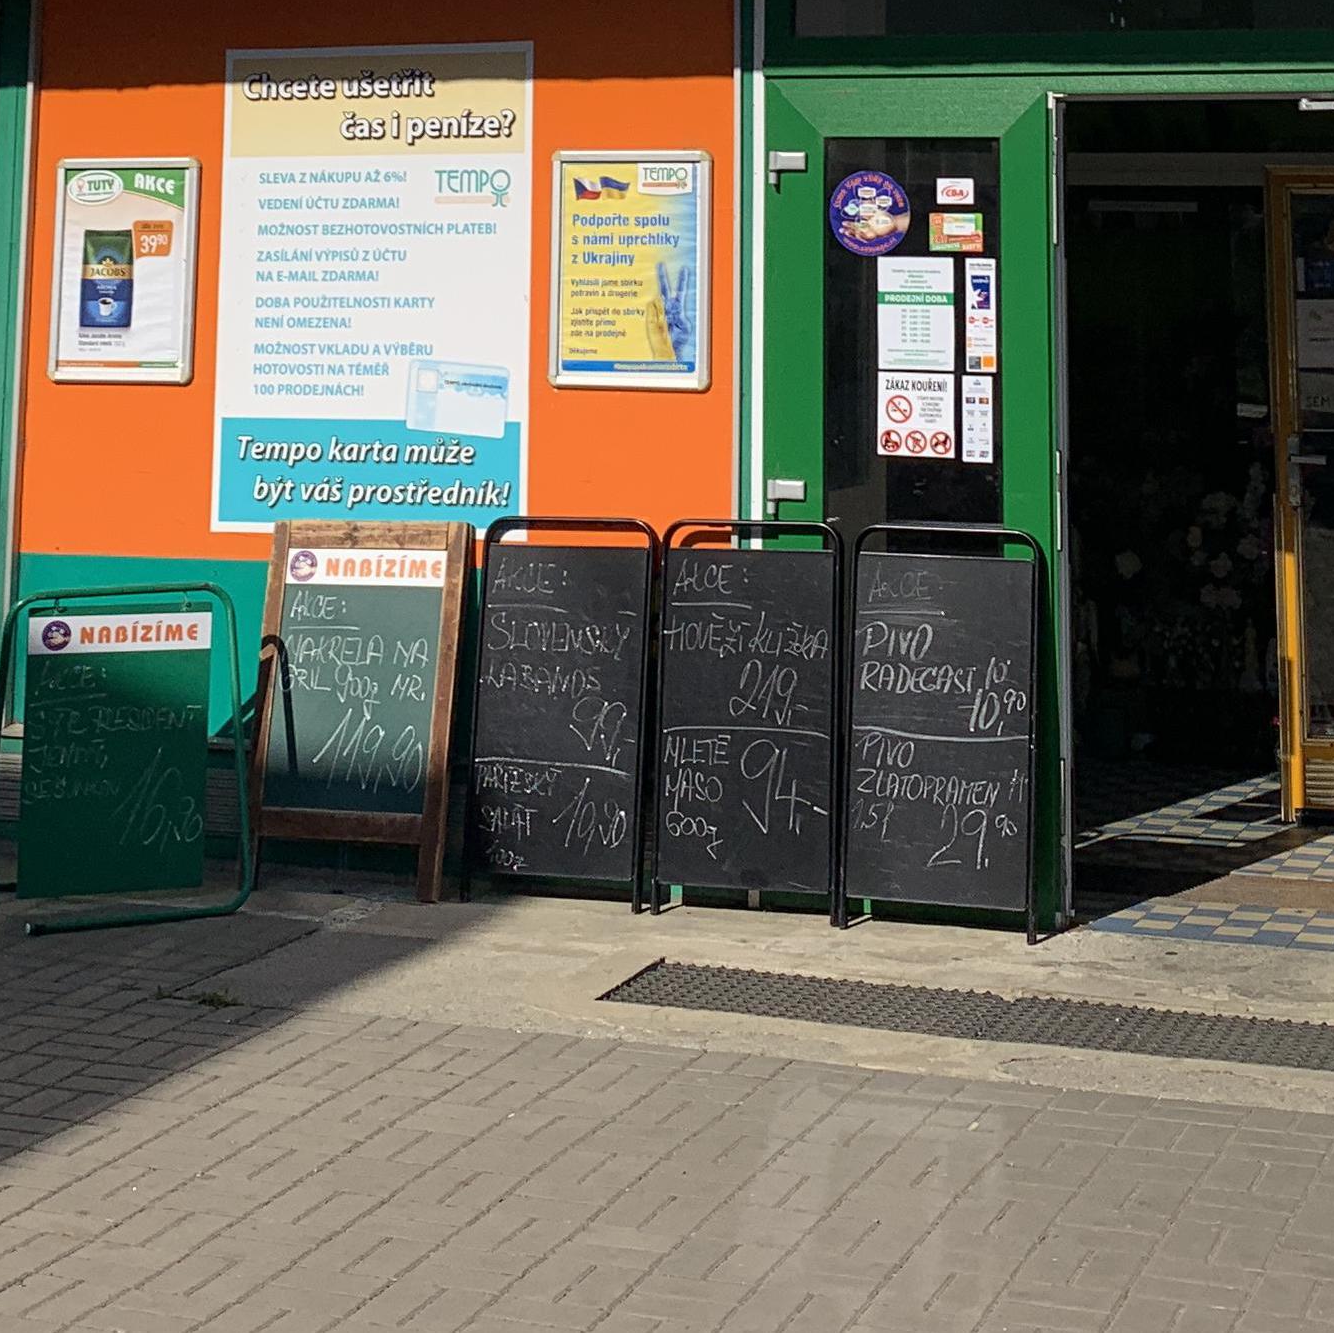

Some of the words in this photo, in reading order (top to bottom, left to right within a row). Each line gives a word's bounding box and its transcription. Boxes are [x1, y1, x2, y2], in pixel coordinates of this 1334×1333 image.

[242, 72, 337, 100] Chcete
[342, 69, 436, 98] ušetřit
[340, 111, 385, 140] čas
[391, 111, 400, 140] i
[406, 109, 516, 146] peníze?
[259, 171, 296, 185] SLEVA
[299, 171, 308, 184] Z
[309, 169, 362, 184] NÁKUPU
[365, 168, 381, 183] AŽ
[383, 170, 407, 183] 6%!
[434, 168, 511, 195] TEMPO
[643, 167, 688, 182] TEMPO
[87, 178, 115, 191] TUTY
[133, 172, 175, 195] AKCE
[258, 196, 303, 210] VEDENÍ
[305, 195, 339, 210] ÚČTU
[342, 196, 400, 210] ZDARMA!
[257, 223, 319, 236] MOŽNOST
[321, 221, 444, 235] BEZHOTOVOSTNÍCH
[446, 222, 497, 235] PLATEB!
[572, 213, 629, 229] Podpořte
[634, 214, 670, 229] spolu
[571, 235, 579, 245] s
[583, 232, 614, 246] námi
[618, 233, 680, 249] uprchlíky
[256, 249, 313, 262] ZASÍLÁNÍ
[315, 248, 359, 262] VÝPISŮ
[362, 250, 370, 262] Z
[372, 248, 407, 262] ÚČTU
[571, 254, 578, 265] z
[582, 252, 635, 267] Ukrajiny
[90, 267, 126, 278] JACOBS
[255, 270, 274, 282] NA
[277, 270, 319, 282] E-MAIL
[321, 270, 379, 282] ZDARMA!
[255, 297, 290, 309] DOBA
[293, 295, 391, 309] POUŽITELNOSTI
[393, 297, 435, 309] KARTY
[884, 293, 925, 304] PRODEJNÍ
[925, 295, 948, 304] DOBA
[254, 315, 284, 328] NENÍ
[286, 317, 352, 329] OMEZENA!
[253, 342, 317, 355] MOŽNOST
[318, 344, 369, 356] VKLADU
[372, 344, 381, 356] A
[383, 341, 434, 356] VÝBĚRU
[253, 363, 324, 375] HOTOVOSTI
[327, 363, 345, 375] NA
[347, 361, 390, 376] TÉMĚŘ
[253, 384, 275, 396] 100
[277, 382, 364, 396] PRODEJNÁCH!
[885, 377, 910, 391] ZÁKAZ
[911, 377, 948, 393] KOUŘENÍ!
[236, 435, 322, 467] Tempo
[327, 436, 398, 464] karta
[403, 436, 476, 465] může
[253, 475, 295, 508] být
[301, 476, 343, 503] váš
[347, 477, 511, 509] prostředník!
[325, 554, 443, 579] NABÍZÍME
[80, 620, 199, 645] NABÍZÍME
[854, 620, 934, 663] PIVO
[393, 637, 430, 668] NA
[854, 731, 915, 769] PIVO
[665, 767, 723, 813] MASO
[855, 768, 1001, 808] ZLATOPRAMEN
